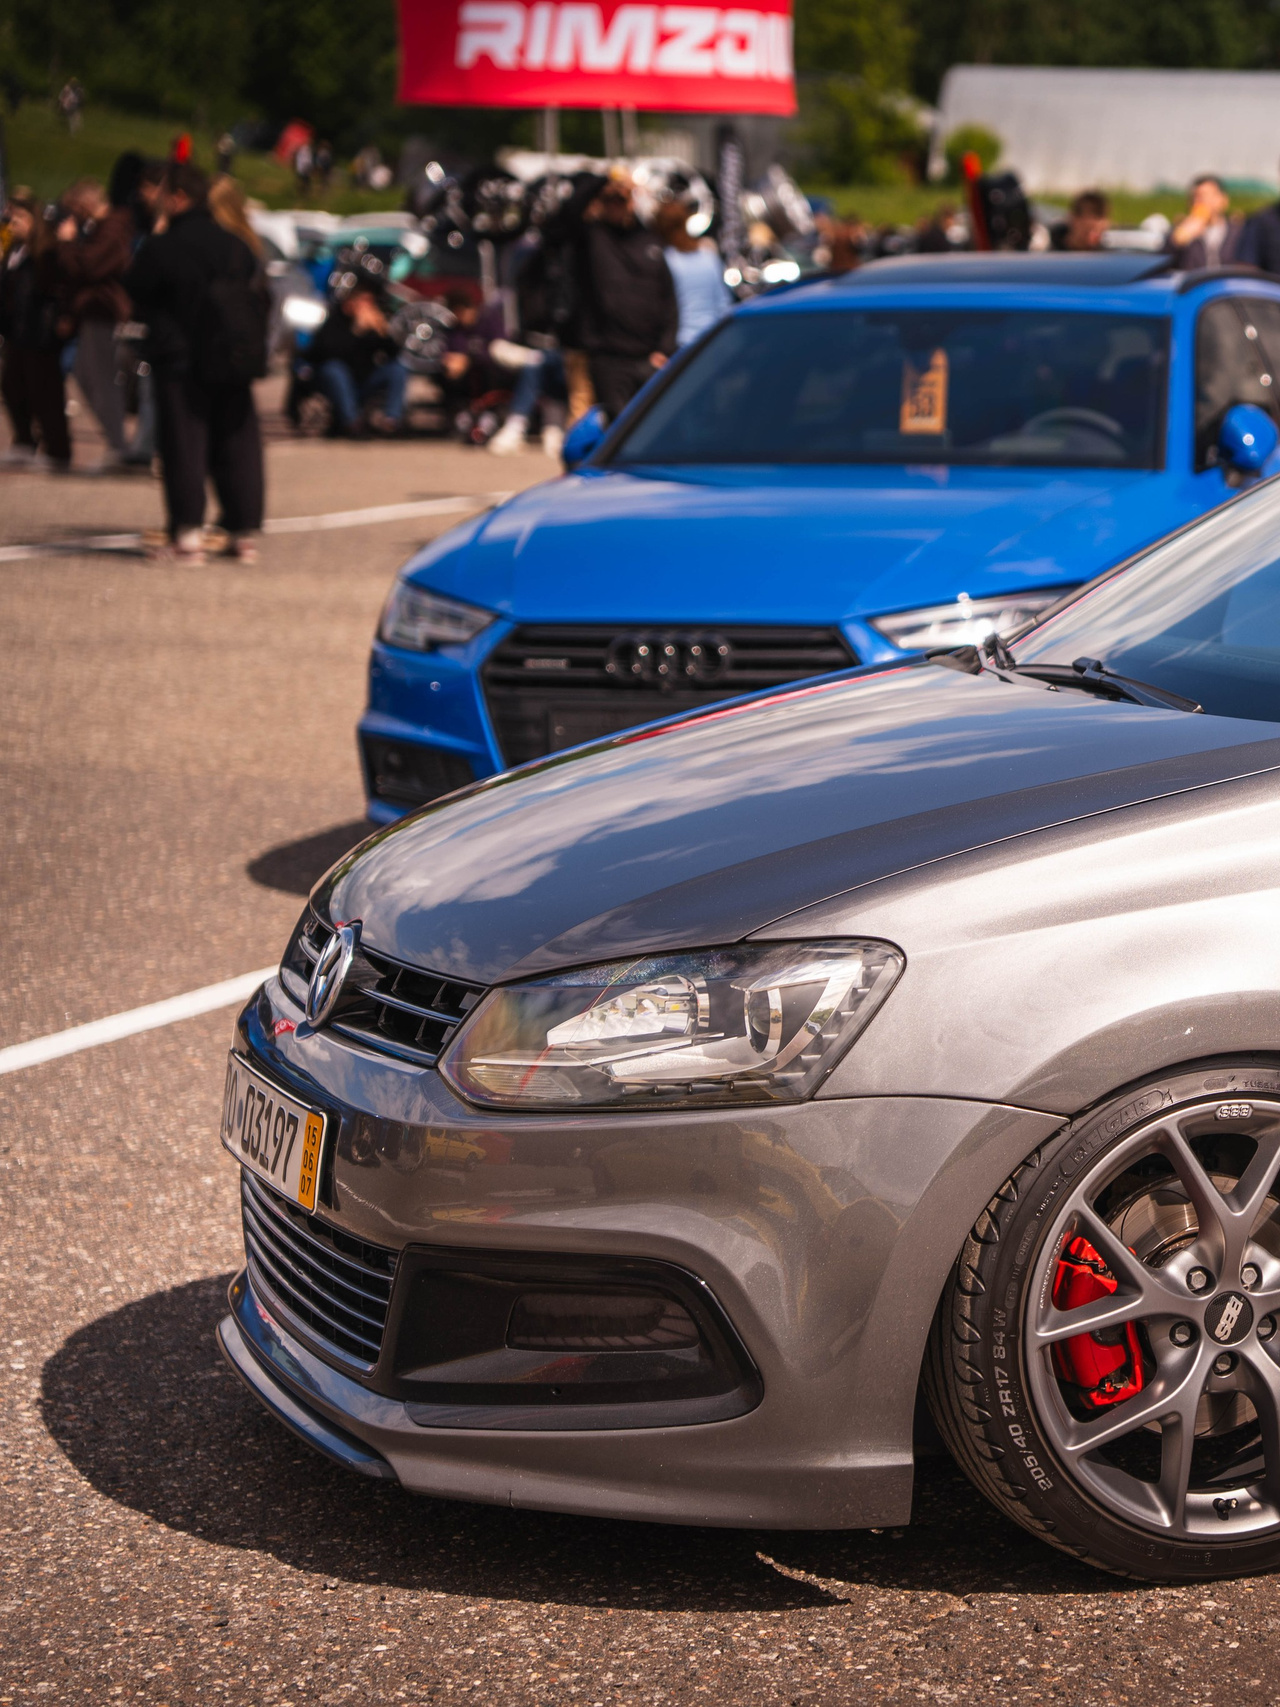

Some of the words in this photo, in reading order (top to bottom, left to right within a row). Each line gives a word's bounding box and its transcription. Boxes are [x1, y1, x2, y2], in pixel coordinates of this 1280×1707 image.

[241, 1083, 299, 1183] 03197
[306, 1124, 318, 1147] 15
[303, 1149, 315, 1171] 06
[300, 1174, 312, 1196] 07
[1214, 1295, 1244, 1341] BBS
[995, 1365, 1017, 1418] ZR17
[1008, 1423, 1054, 1491] 205/40
